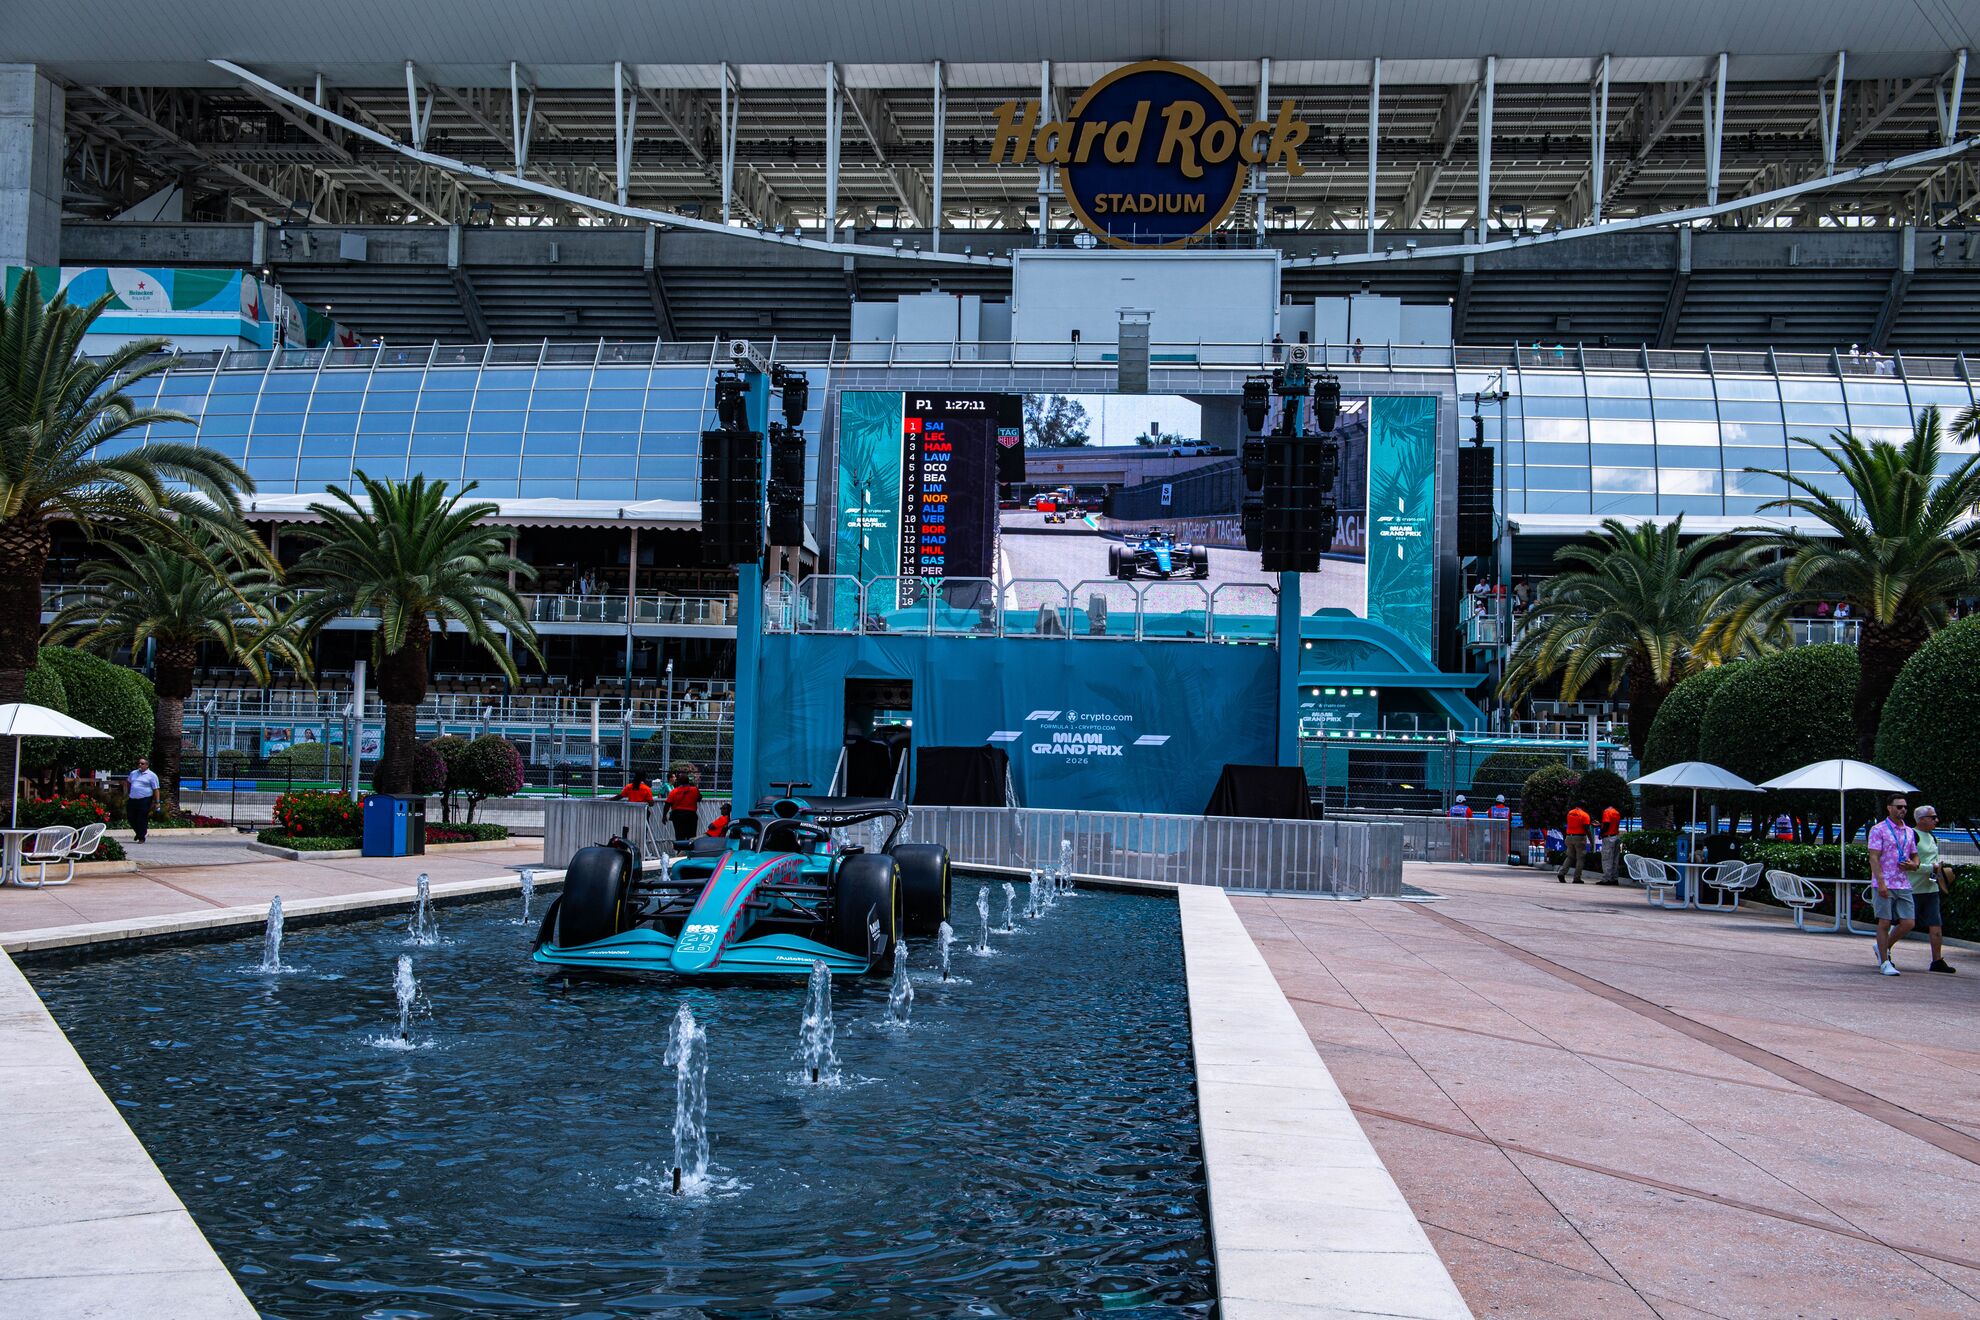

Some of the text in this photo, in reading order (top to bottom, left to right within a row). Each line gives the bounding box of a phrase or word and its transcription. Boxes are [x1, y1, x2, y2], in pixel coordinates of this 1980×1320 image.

[988, 100, 1310, 178] Hard Rock
[1094, 193, 1205, 213] STADIUM
[916, 399, 985, 410] P1 1:27:11
[910, 422, 944, 431] 1 SAI
[924, 432, 945, 441] LEC
[1000, 428, 1017, 436] TAG
[909, 443, 952, 451] 3 HAM
[924, 453, 951, 461] LAW
[908, 463, 947, 472] 5 OCO
[908, 474, 947, 482] 6 BEA
[908, 484, 942, 492] 7 LIN
[908, 494, 949, 503] 8 NOR
[908, 504, 945, 513] 9 ALB
[904, 514, 945, 523] 10 VER
[904, 525, 946, 534] 11 BOR
[904, 535, 946, 544] 12 HAD
[903, 546, 945, 555] 13 HUL
[903, 556, 945, 564] 14 GAS
[902, 566, 943, 575] 15 PER
[902, 587, 943, 596] 17 AO
[902, 598, 914, 606] 18
[1080, 713, 1133, 722] crypto.com
[1053, 732, 1103, 744] MIAMI
[1031, 743, 1123, 756] GRAND PRIX
[1065, 757, 1089, 765] 2026
